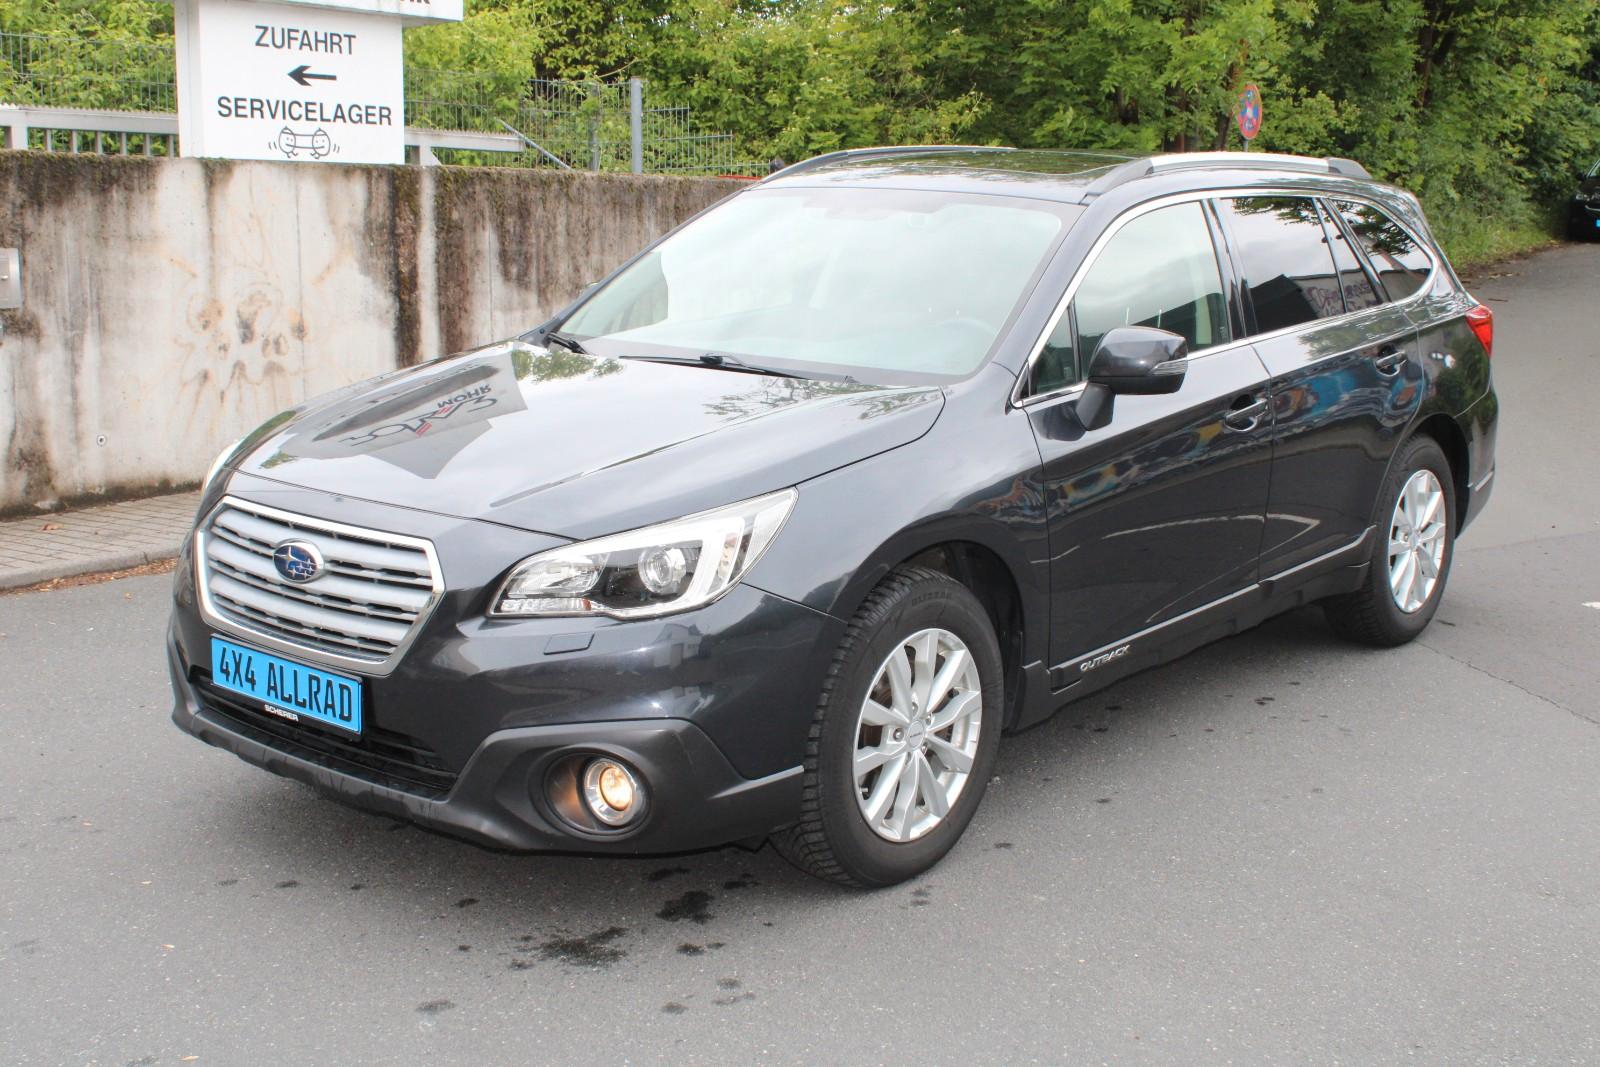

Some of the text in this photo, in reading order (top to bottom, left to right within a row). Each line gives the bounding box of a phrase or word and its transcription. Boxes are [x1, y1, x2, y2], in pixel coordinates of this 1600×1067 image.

[255, 25, 357, 55] ZUFAHRT
[217, 96, 392, 126] SERVICELAGER
[1080, 644, 1131, 671] OUTBACK
[219, 646, 352, 722] 4X4 ALLRAD
[264, 704, 299, 722] SCHERER
